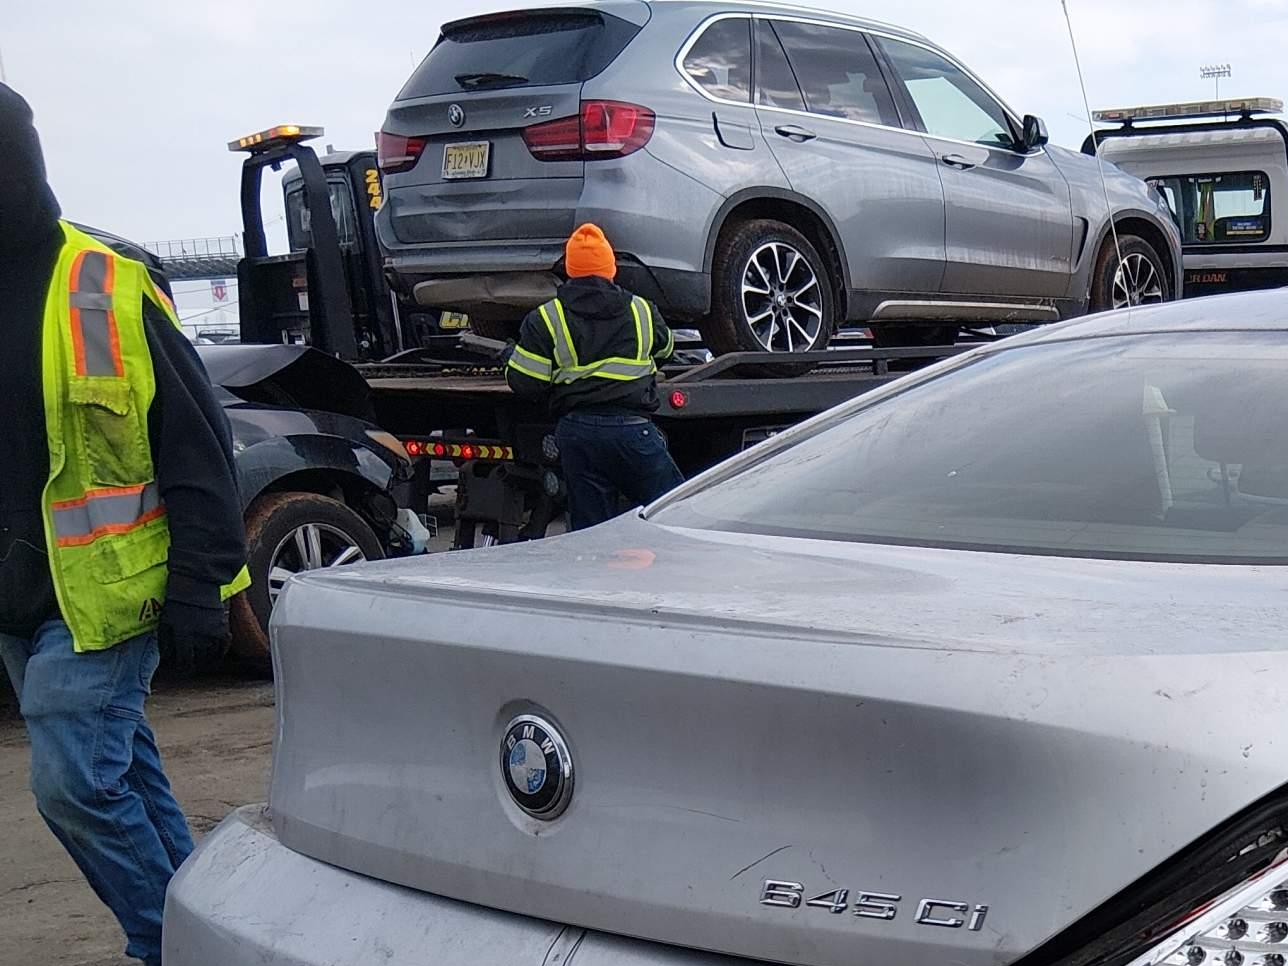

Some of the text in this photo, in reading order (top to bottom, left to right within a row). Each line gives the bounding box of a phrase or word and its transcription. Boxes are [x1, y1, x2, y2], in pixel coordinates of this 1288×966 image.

[523, 105, 553, 118] X5
[506, 725, 556, 755] BMW
[760, 879, 989, 932] 645 Ci
